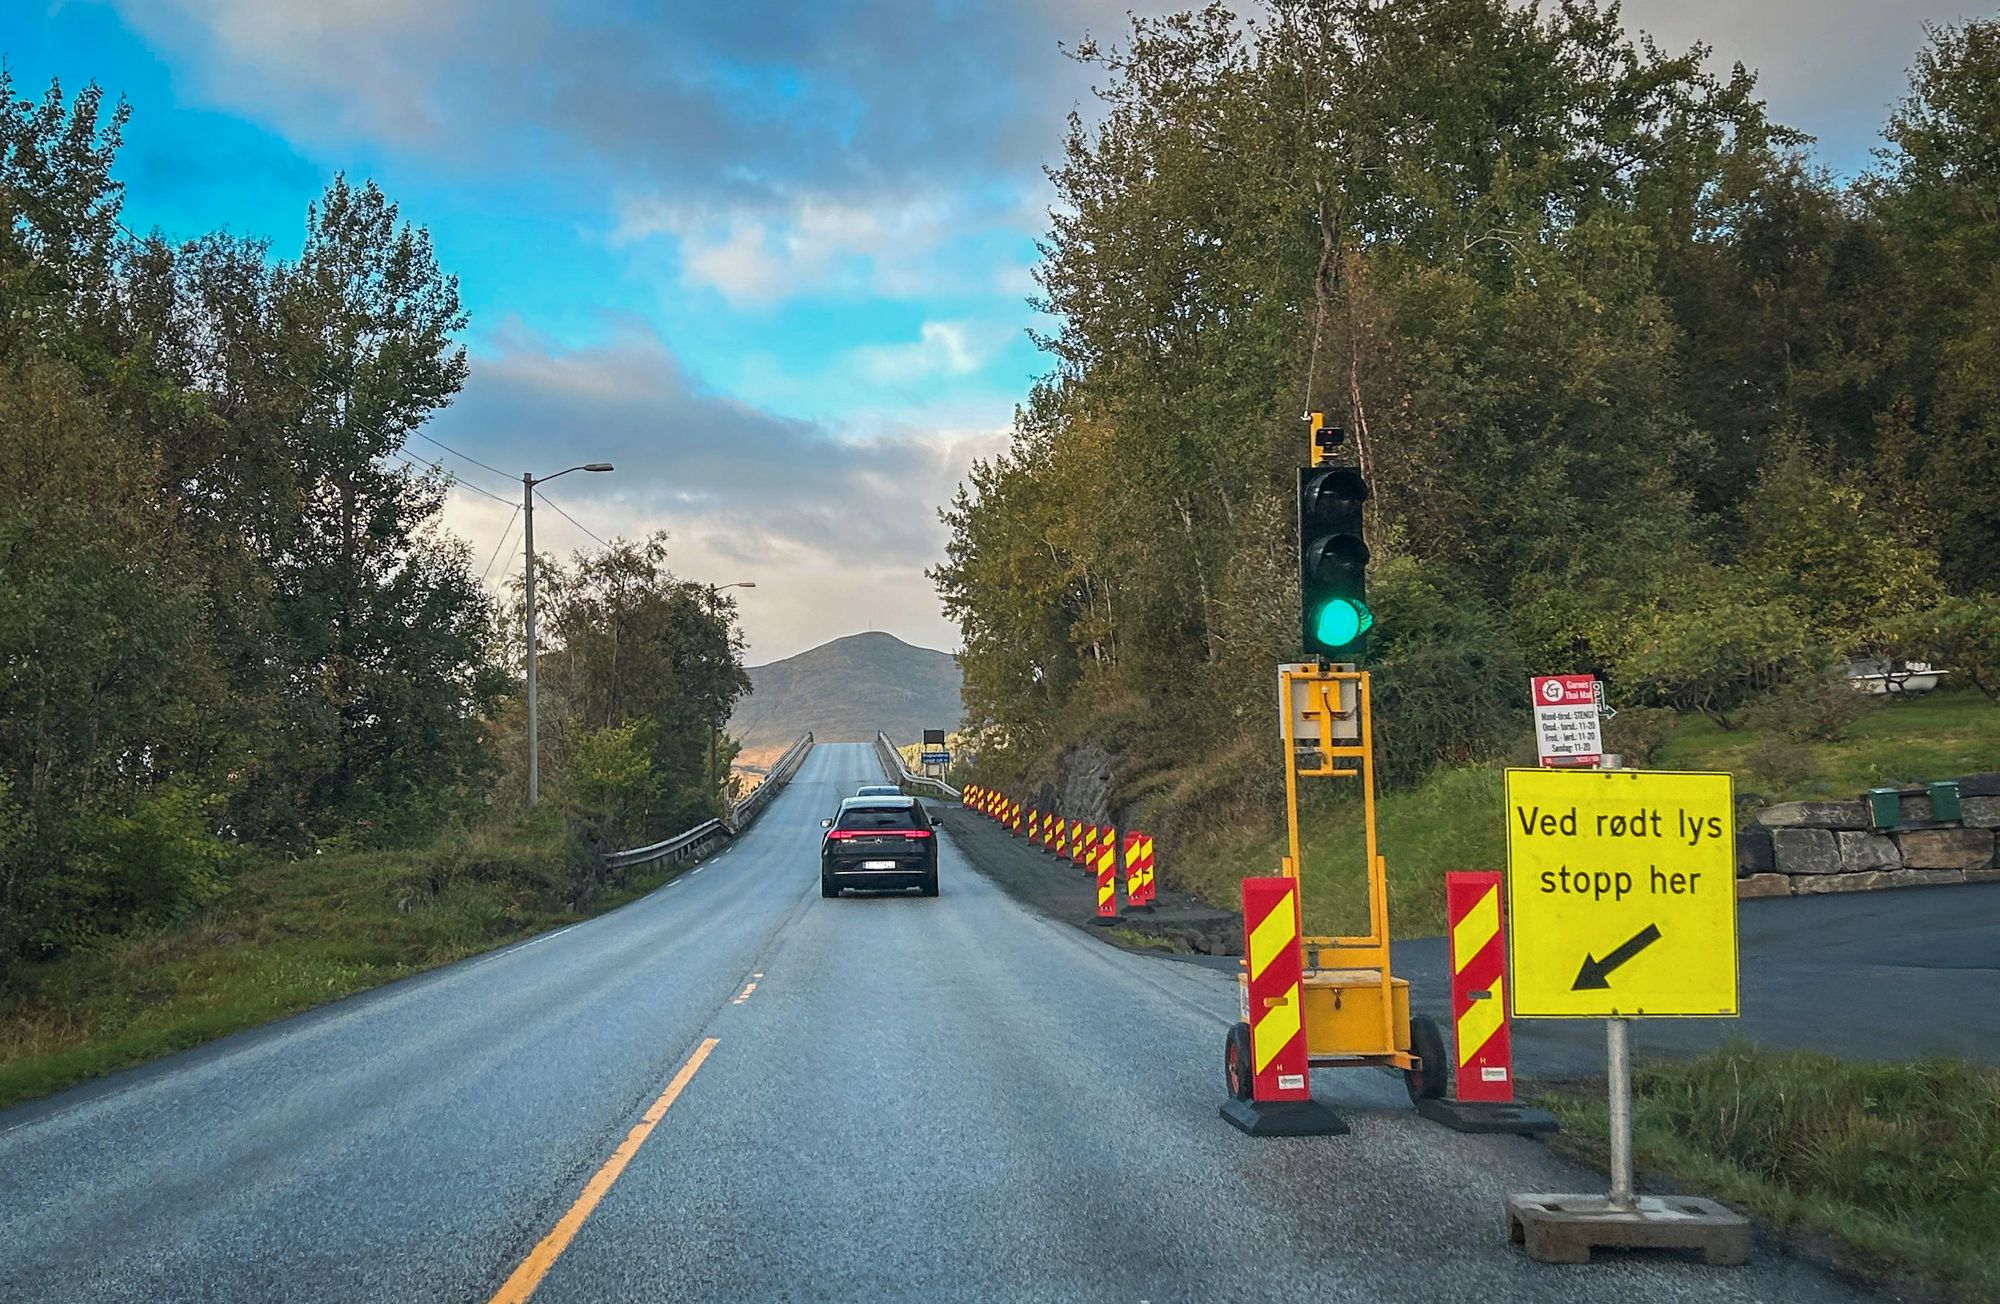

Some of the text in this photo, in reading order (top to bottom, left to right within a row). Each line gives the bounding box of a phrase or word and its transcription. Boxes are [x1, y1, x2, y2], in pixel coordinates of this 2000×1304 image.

[1593, 683, 1603, 713] OPEN
[1579, 721, 1596, 730] 11-20
[1578, 732, 1595, 740] 11-20
[1574, 742, 1591, 751] 11-20
[1517, 806, 1723, 846] Ved rødt lys
[1540, 864, 1702, 901] stopp her
[1480, 1057, 1486, 1065] H
